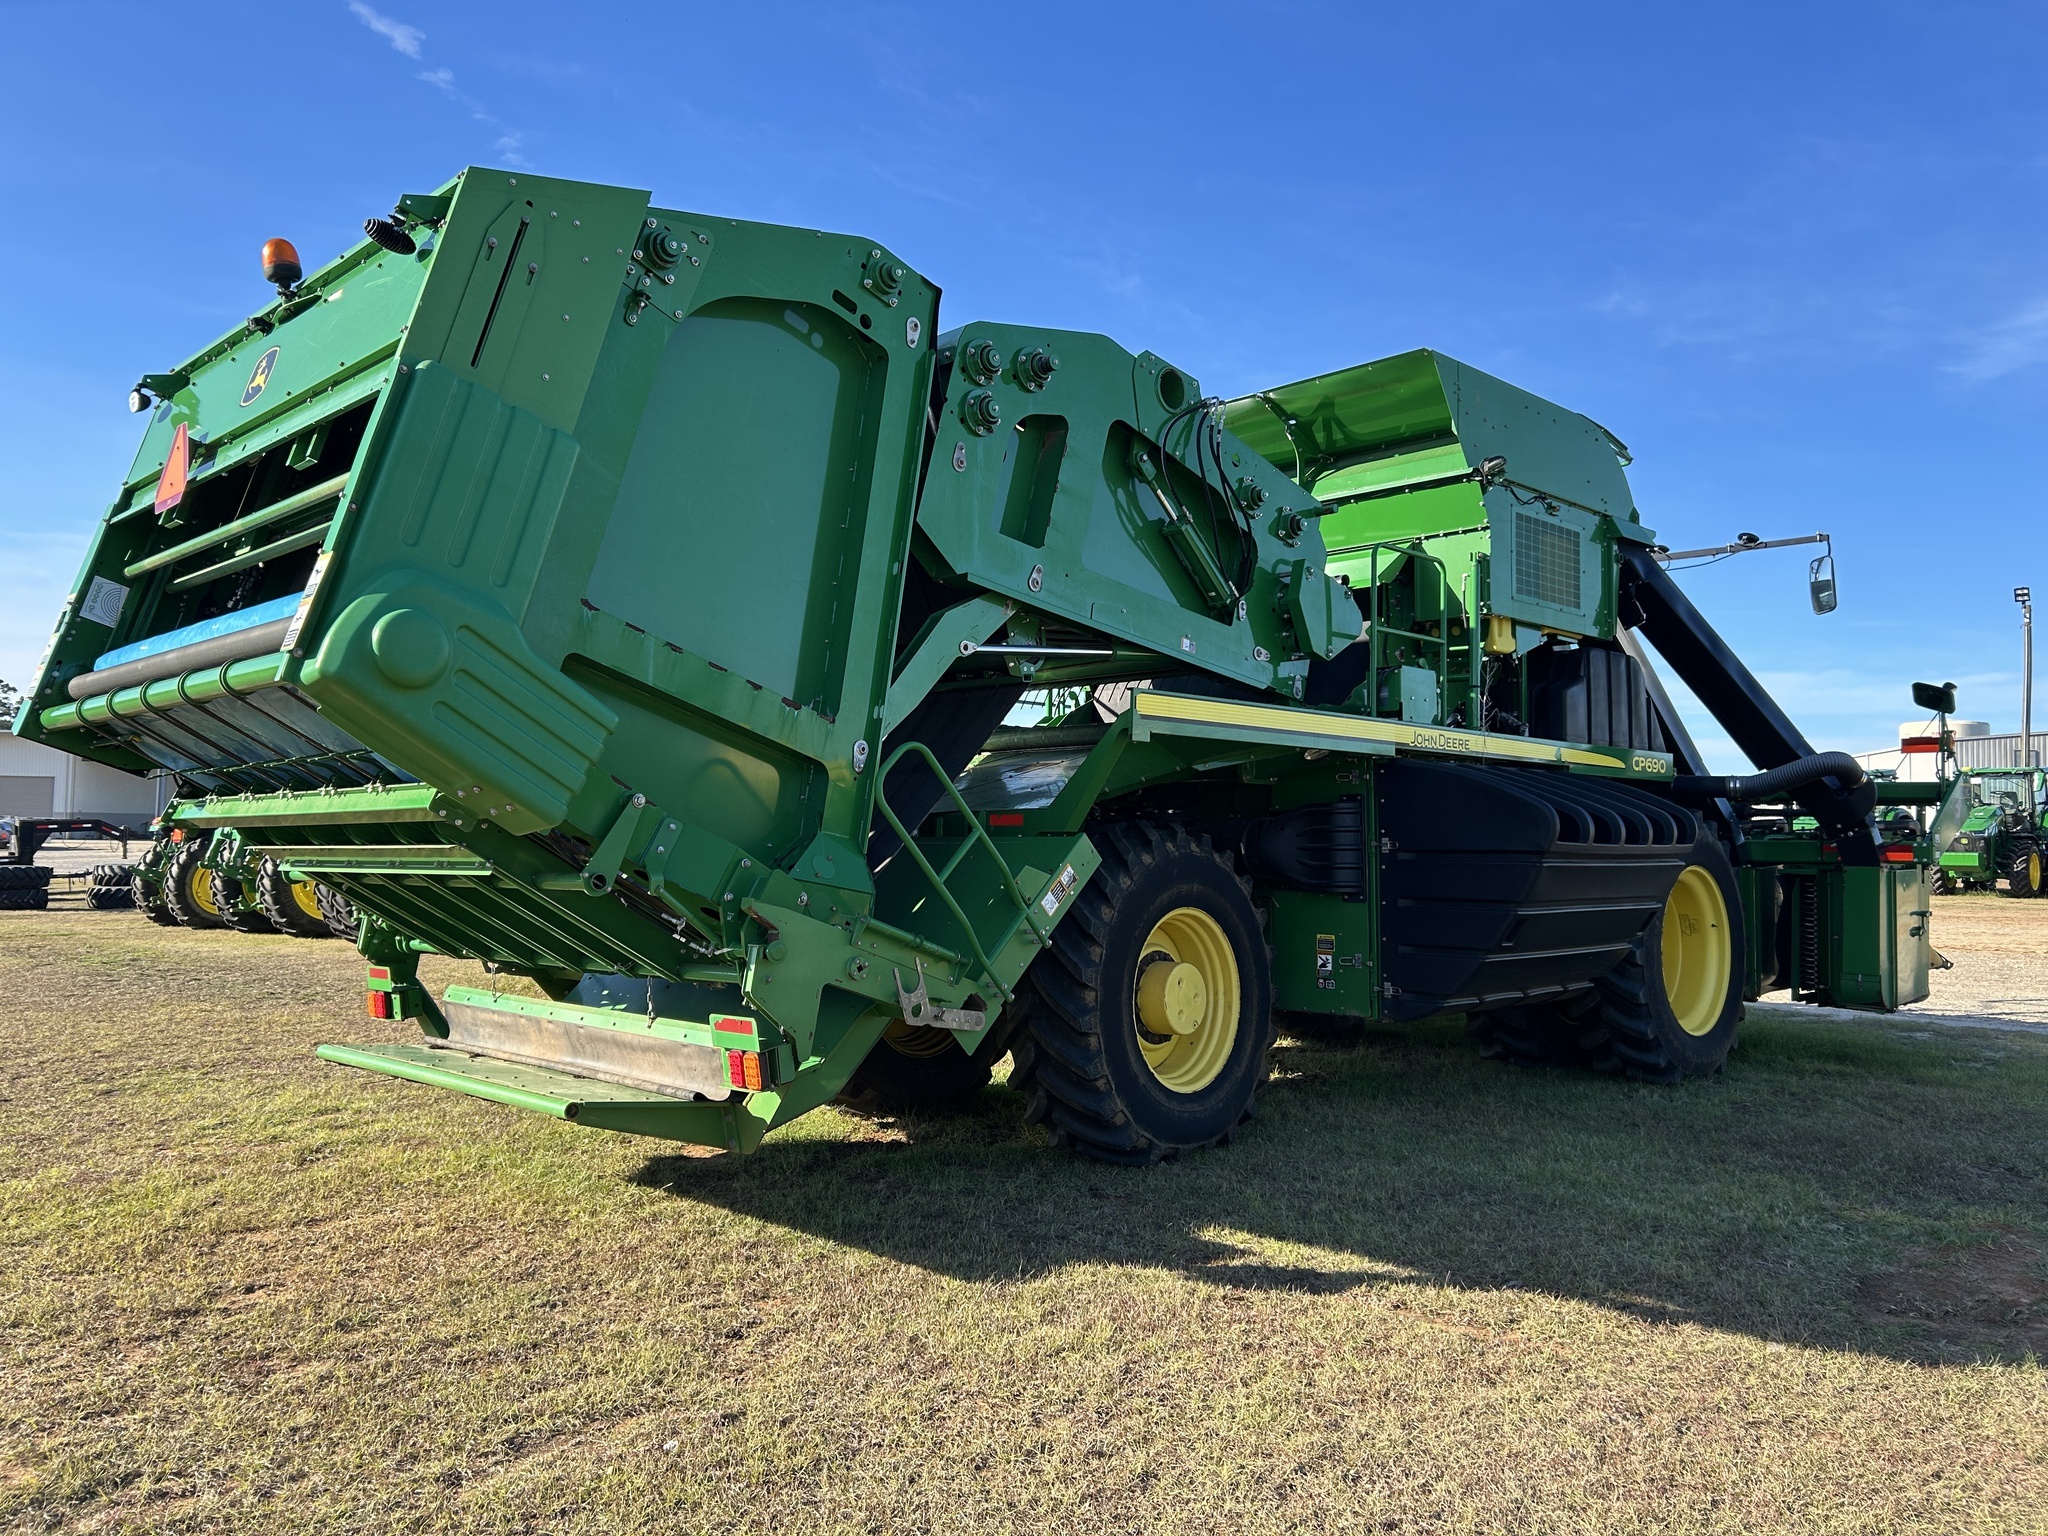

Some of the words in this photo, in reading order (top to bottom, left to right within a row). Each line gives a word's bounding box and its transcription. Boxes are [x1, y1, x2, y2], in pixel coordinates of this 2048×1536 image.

[1410, 731, 1438, 748] JOHN
[1438, 733, 1471, 750] DEERE
[1632, 756, 1666, 774] CP690
